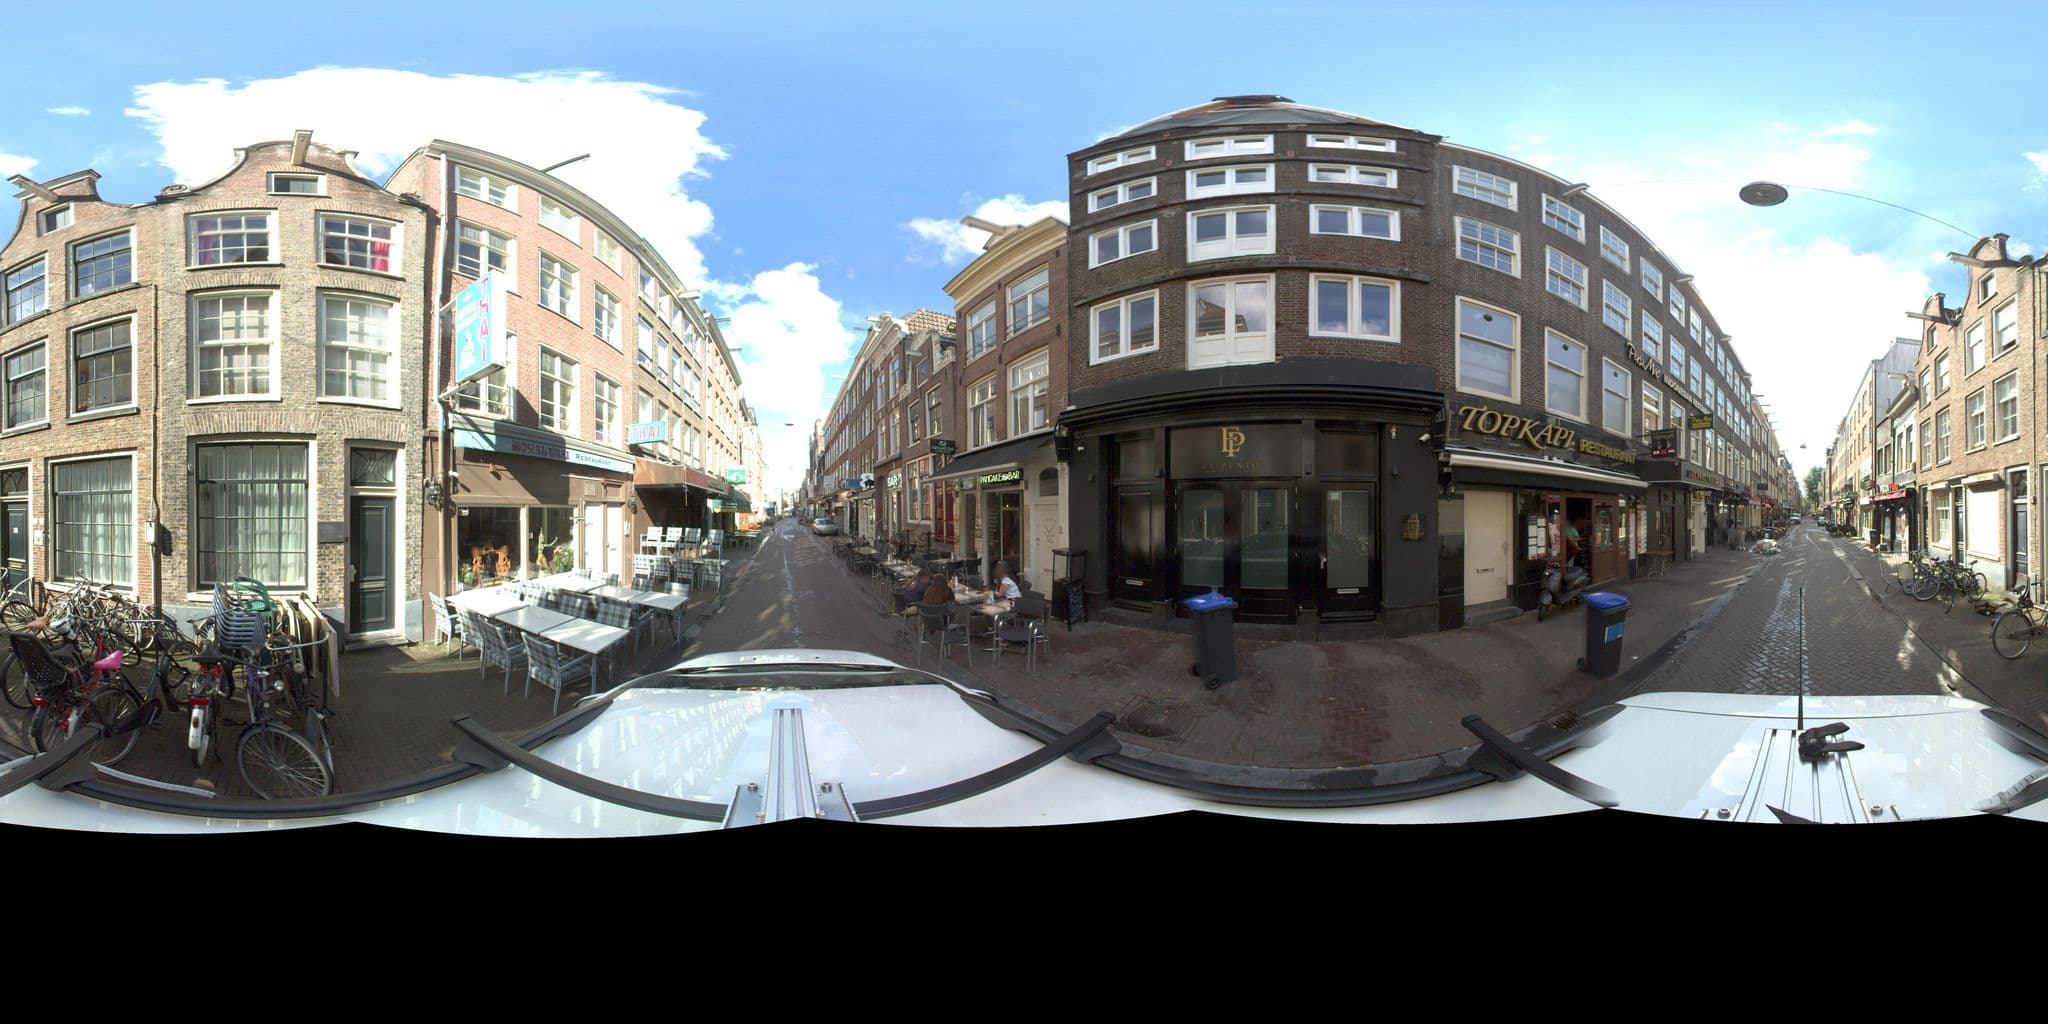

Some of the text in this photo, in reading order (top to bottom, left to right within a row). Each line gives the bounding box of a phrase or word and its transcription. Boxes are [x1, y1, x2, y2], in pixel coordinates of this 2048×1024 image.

[480, 276, 489, 362] THAI
[632, 426, 661, 440] THAI
[1459, 405, 1637, 464] TOPKAPI RESTAURANT
